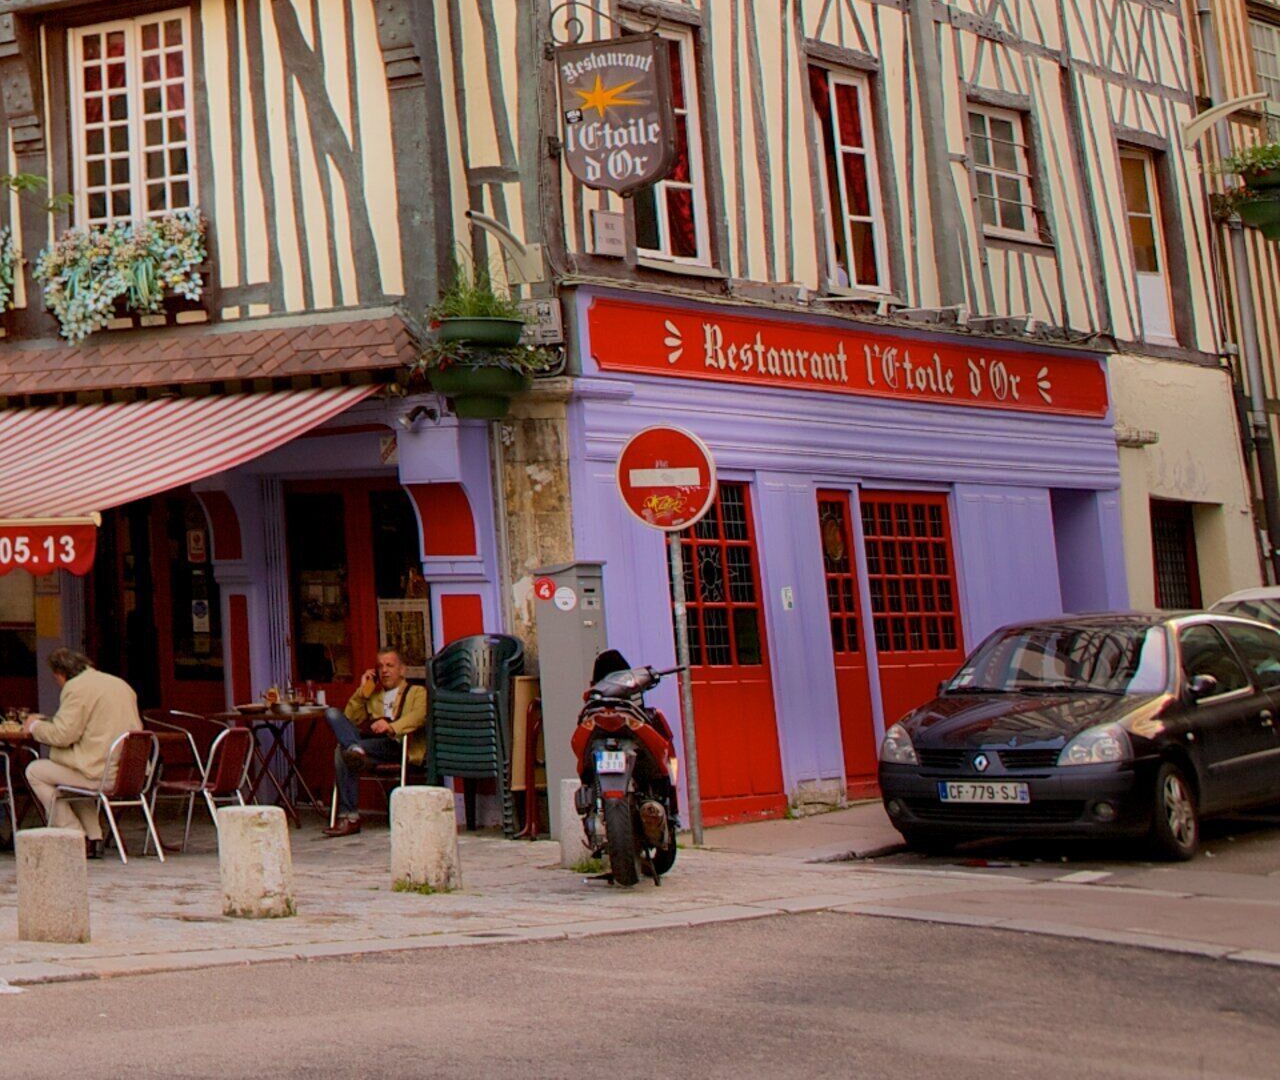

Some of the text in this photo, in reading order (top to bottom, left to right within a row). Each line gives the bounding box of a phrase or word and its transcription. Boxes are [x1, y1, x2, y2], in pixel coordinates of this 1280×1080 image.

[561, 52, 654, 85] Restaurant
[565, 118, 661, 153] l'Etoile
[584, 148, 649, 181] d'Or
[702, 322, 1021, 401] Restaurant l'Etoile d'Or
